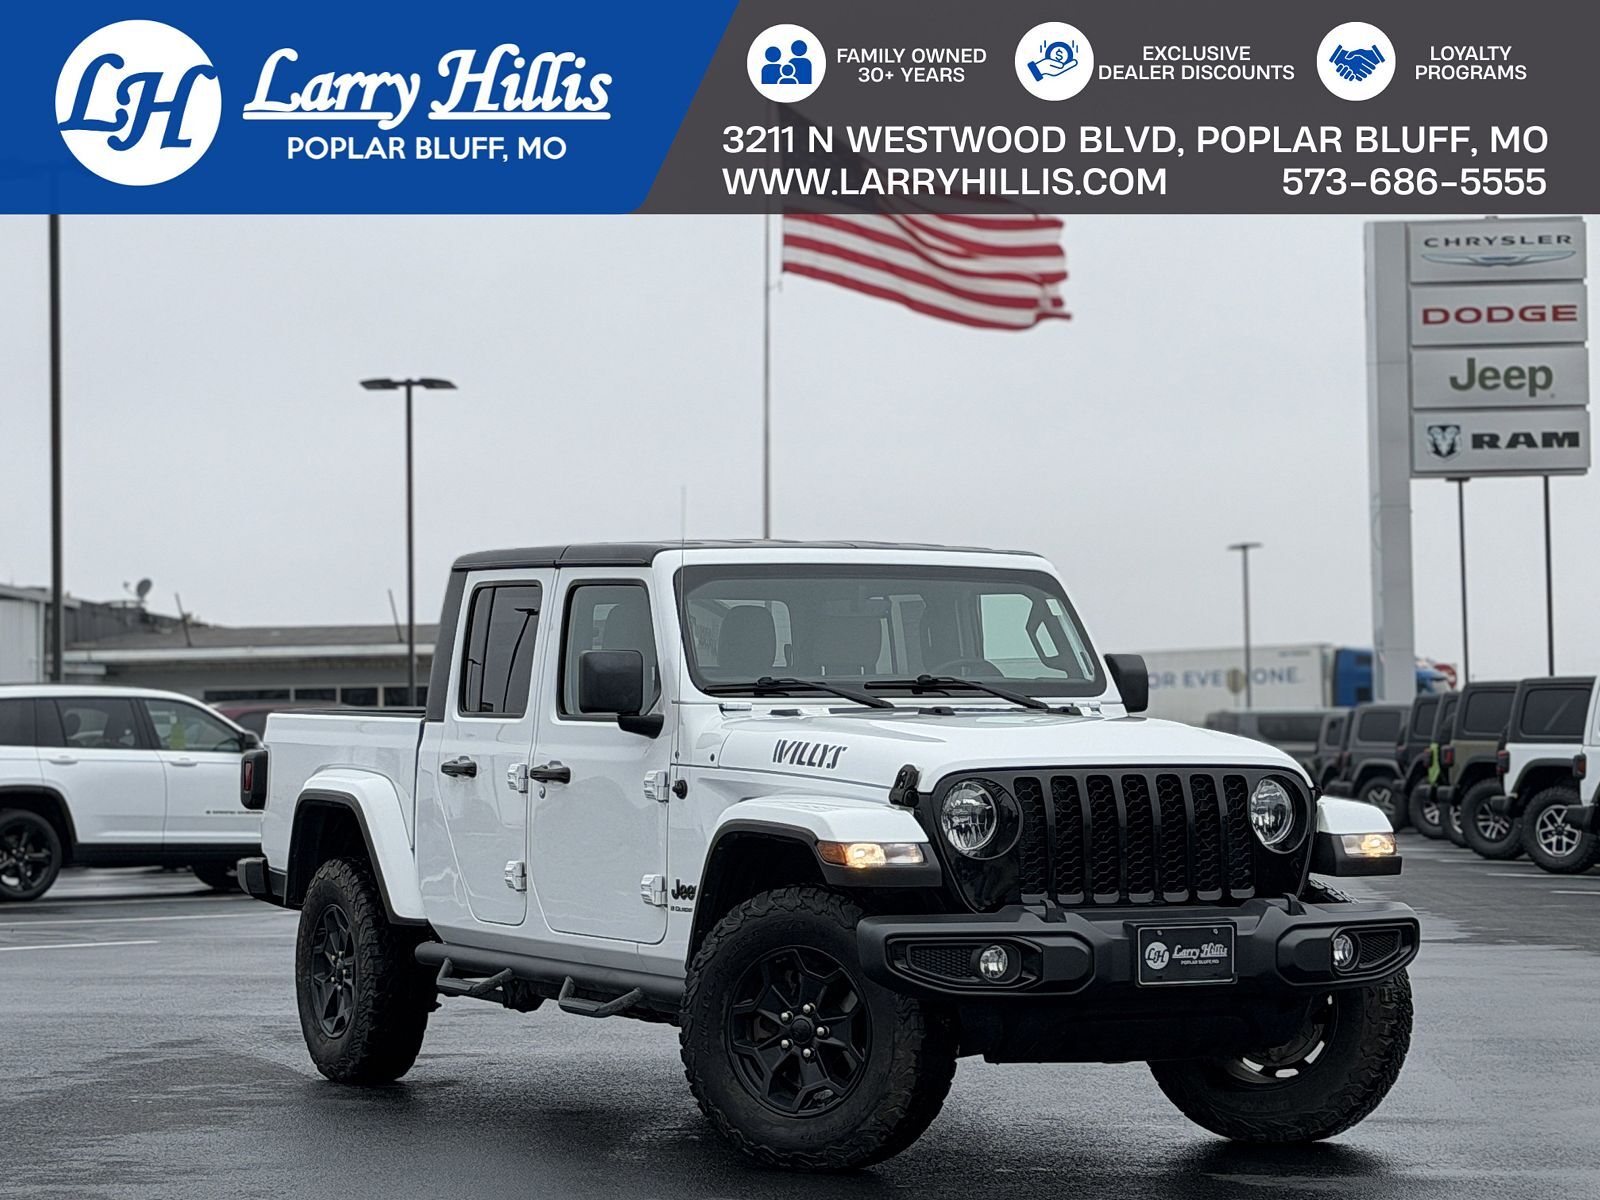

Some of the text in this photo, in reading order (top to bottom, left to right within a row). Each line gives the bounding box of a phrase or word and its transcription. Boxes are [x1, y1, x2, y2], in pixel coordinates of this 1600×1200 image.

[1423, 234, 1573, 248] CHRYSLER
[1422, 304, 1578, 325] DODGE
[1449, 357, 1554, 398] Jeep
[1471, 431, 1580, 450] RAM
[1183, 666, 1298, 689] EVEONE
[772, 738, 848, 770] WILLYS
[671, 878, 697, 901] Jee
[1172, 943, 1228, 959] Larry Hillis
